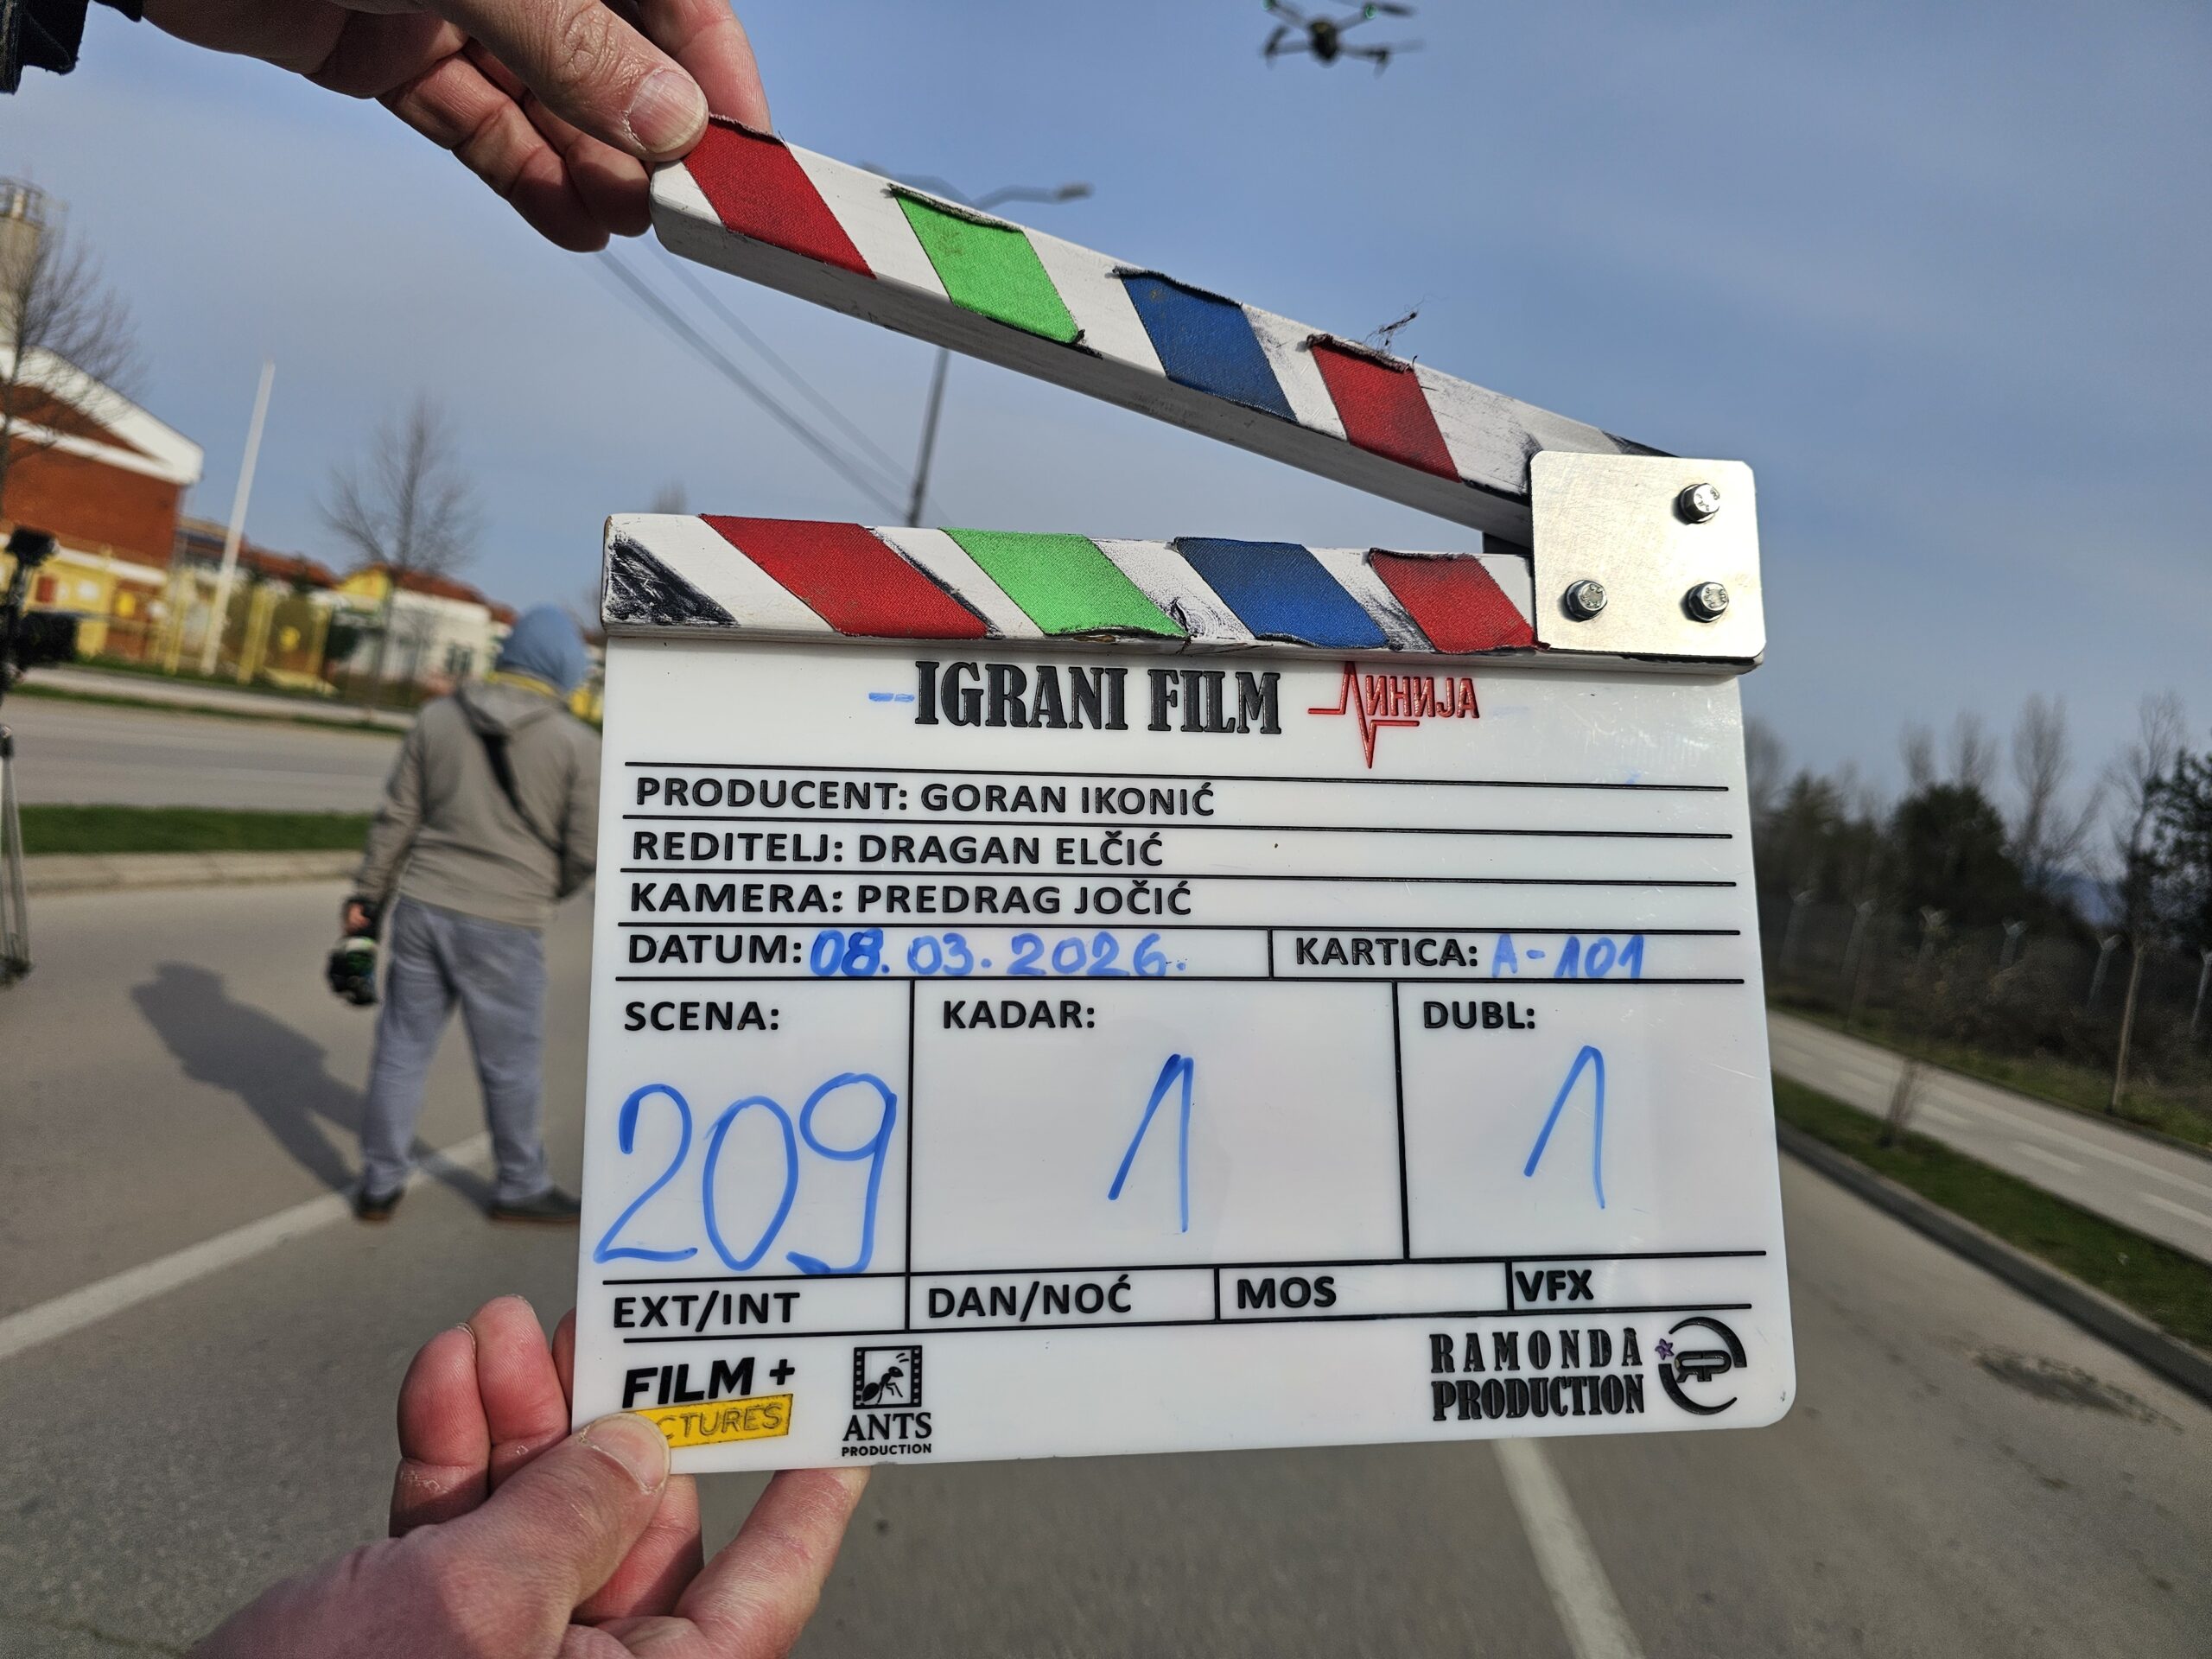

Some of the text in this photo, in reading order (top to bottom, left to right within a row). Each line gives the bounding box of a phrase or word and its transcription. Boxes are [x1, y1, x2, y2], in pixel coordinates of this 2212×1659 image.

[915, 660, 1282, 734] IGRANI FILM
[636, 778, 1215, 816] PRODUCENT: GORAN IKONIĆ
[633, 830, 1163, 867] REDITELJ: DRAGAN ELČIĆ
[632, 880, 1192, 915] KAMERA: PREDRAG JOČIĆ
[629, 935, 802, 964] DATUM:
[1296, 938, 1478, 967] KARTICA:
[624, 1001, 779, 1032] SCENA:
[944, 1001, 1095, 1029] KADAR:
[1424, 1001, 1535, 1030] DUBL:
[1107, 1053, 1195, 1233] 1
[1523, 1046, 1606, 1210] 1
[594, 1072, 897, 1274] 209
[928, 1274, 1133, 1321] DAN/NOĆ
[1237, 1276, 1337, 1309] MOS
[1515, 1269, 1594, 1302] VFX
[614, 1291, 800, 1332] EXT/INT
[1430, 1328, 1643, 1373] RAMONDA
[622, 1357, 755, 1408] FILM
[1432, 1374, 1644, 1421] PRODUCTION
[658, 1402, 783, 1440] CTURES
[842, 1412, 932, 1441] ANTS
[842, 1443, 932, 1457] PRODUCTION
